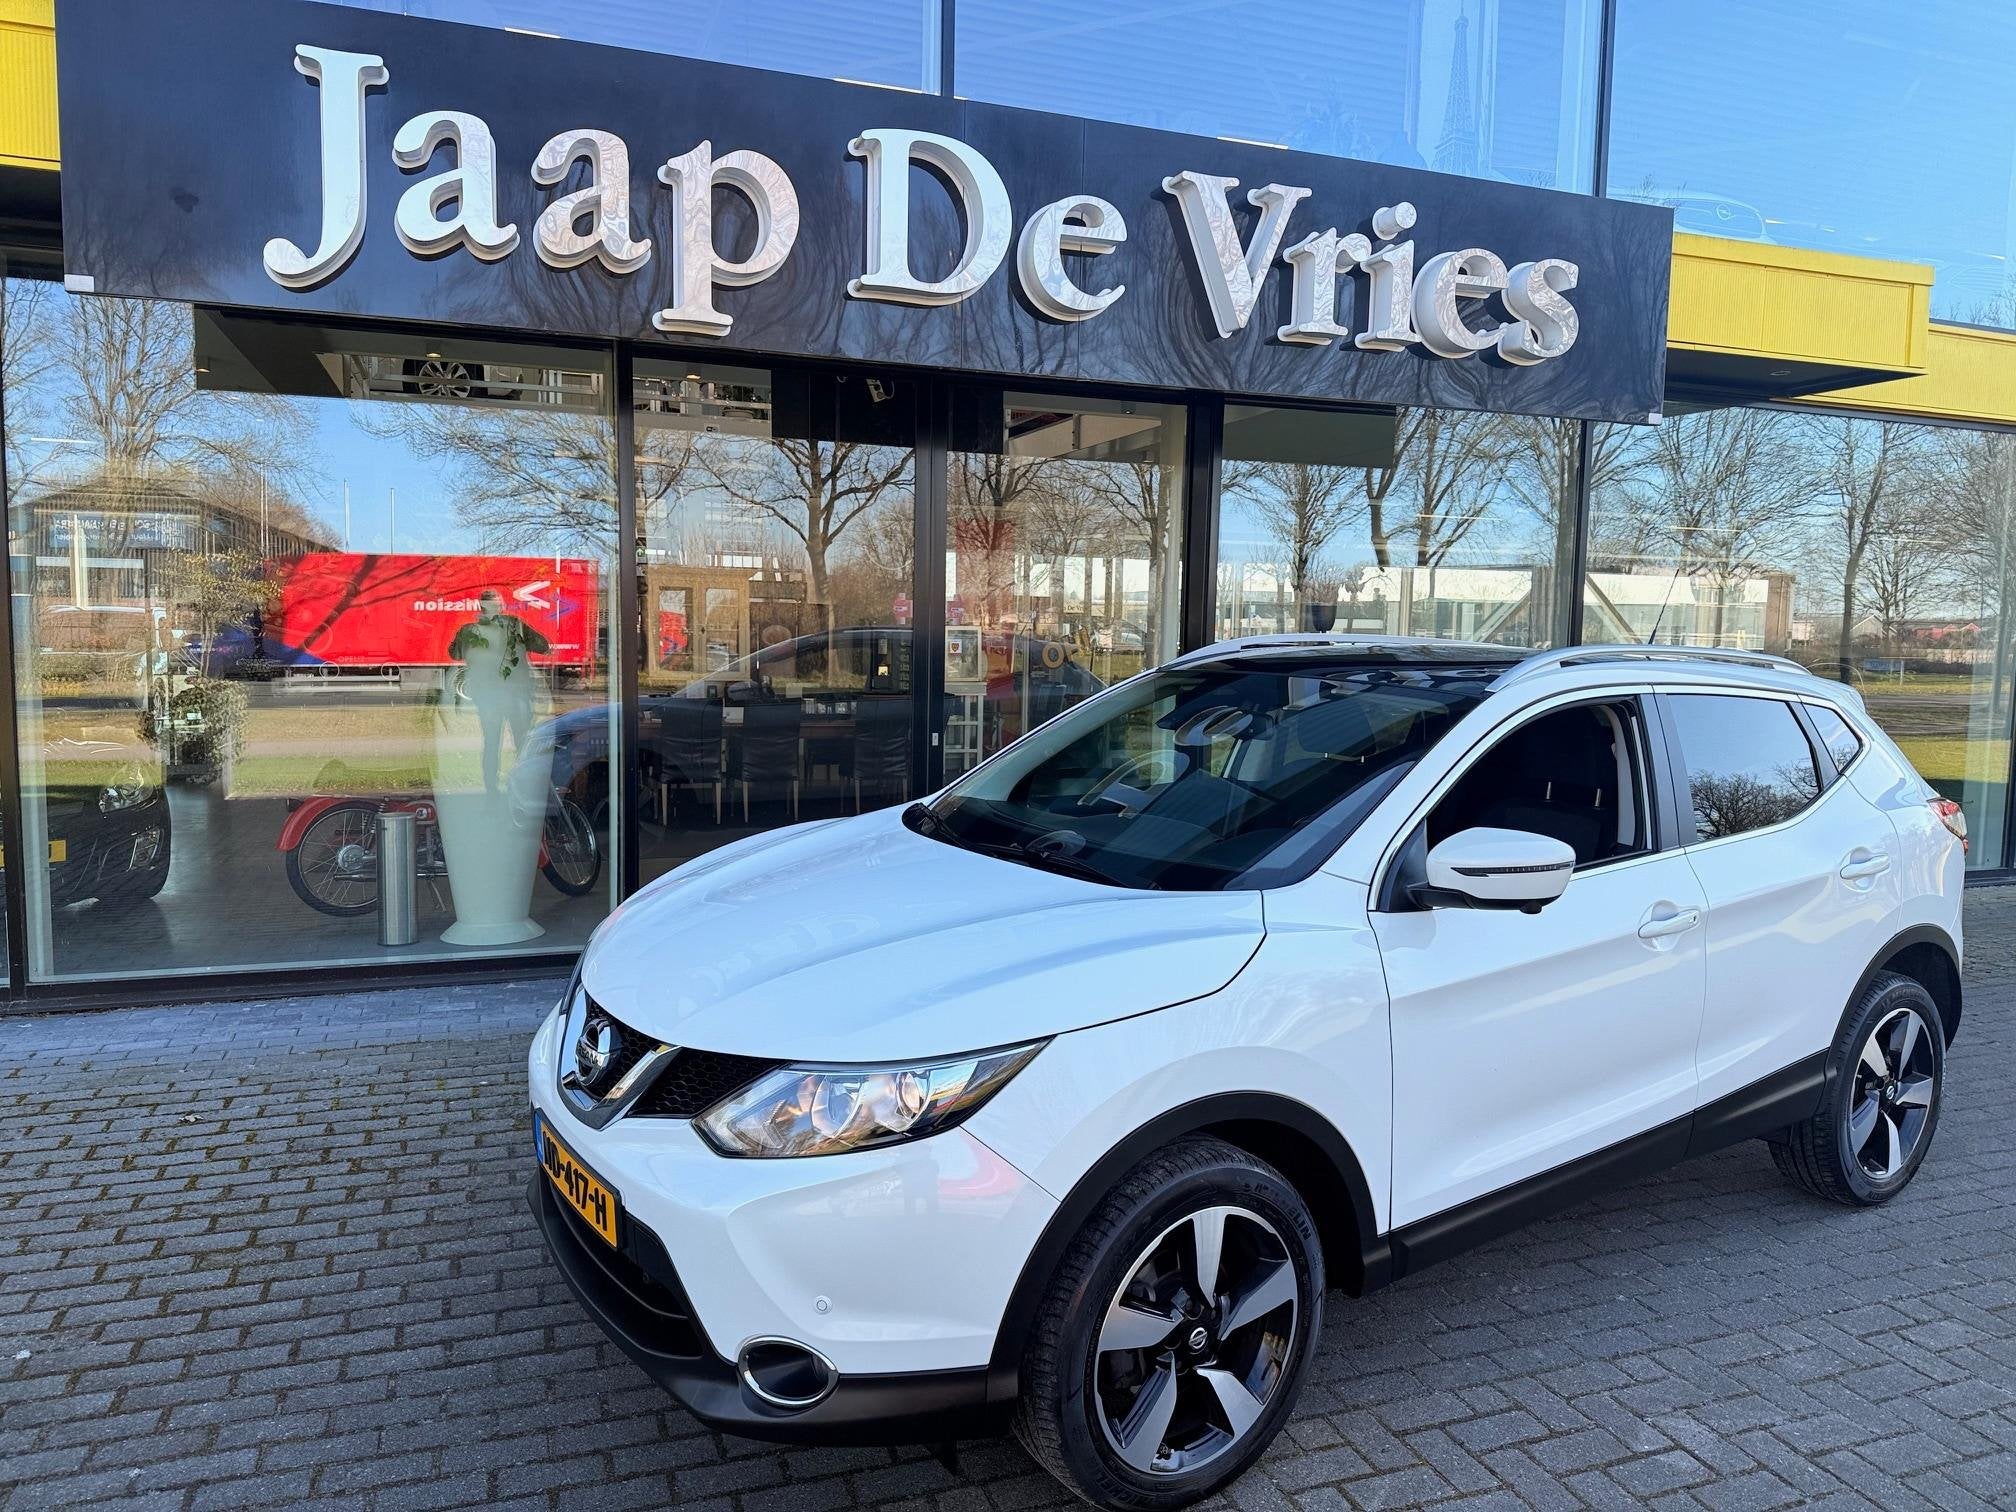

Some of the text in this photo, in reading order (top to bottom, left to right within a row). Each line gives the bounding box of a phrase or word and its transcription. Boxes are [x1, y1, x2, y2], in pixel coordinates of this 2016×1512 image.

[263, 44, 1580, 366] Jaap De Vries
